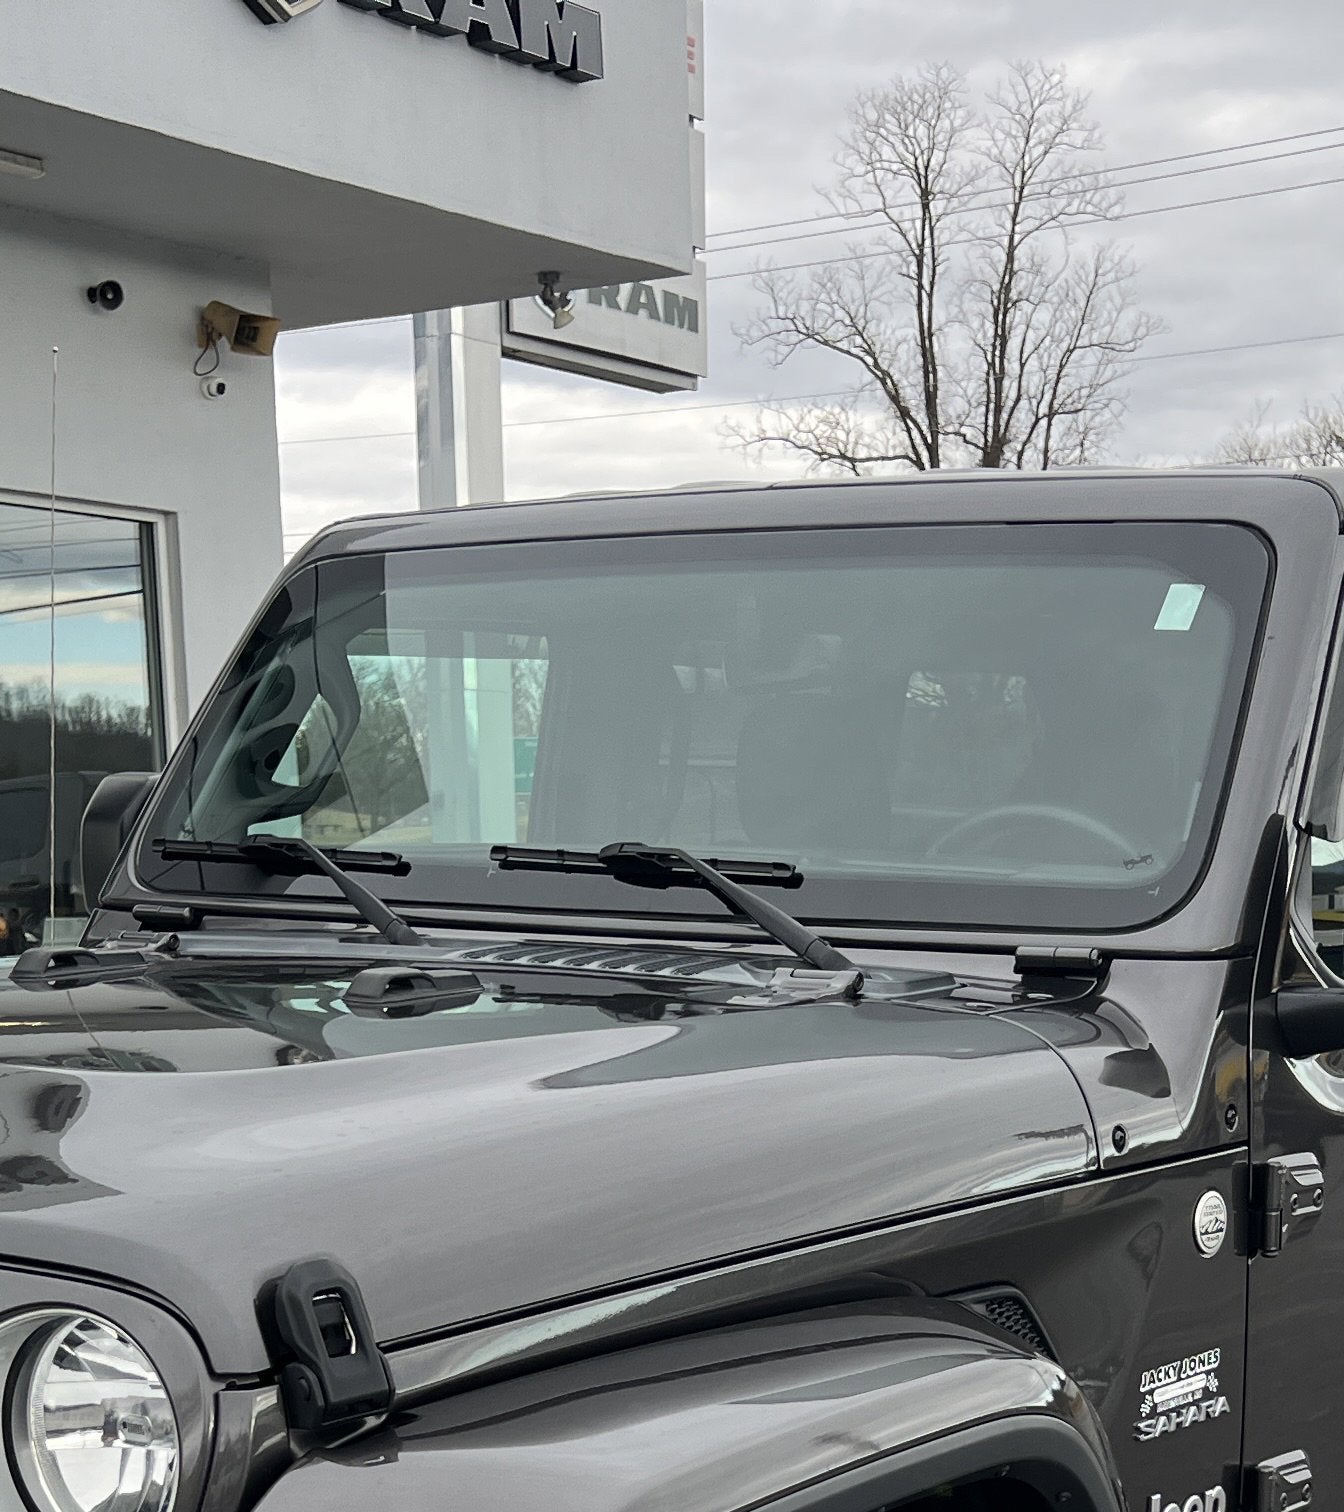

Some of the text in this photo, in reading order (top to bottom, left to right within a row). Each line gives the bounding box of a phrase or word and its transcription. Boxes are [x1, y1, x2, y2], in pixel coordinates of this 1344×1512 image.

[339, 0, 604, 84] AM
[1140, 1361, 1181, 1393] JACKY
[1180, 1348, 1220, 1379] JONES
[1133, 1396, 1231, 1442] SAHARA
